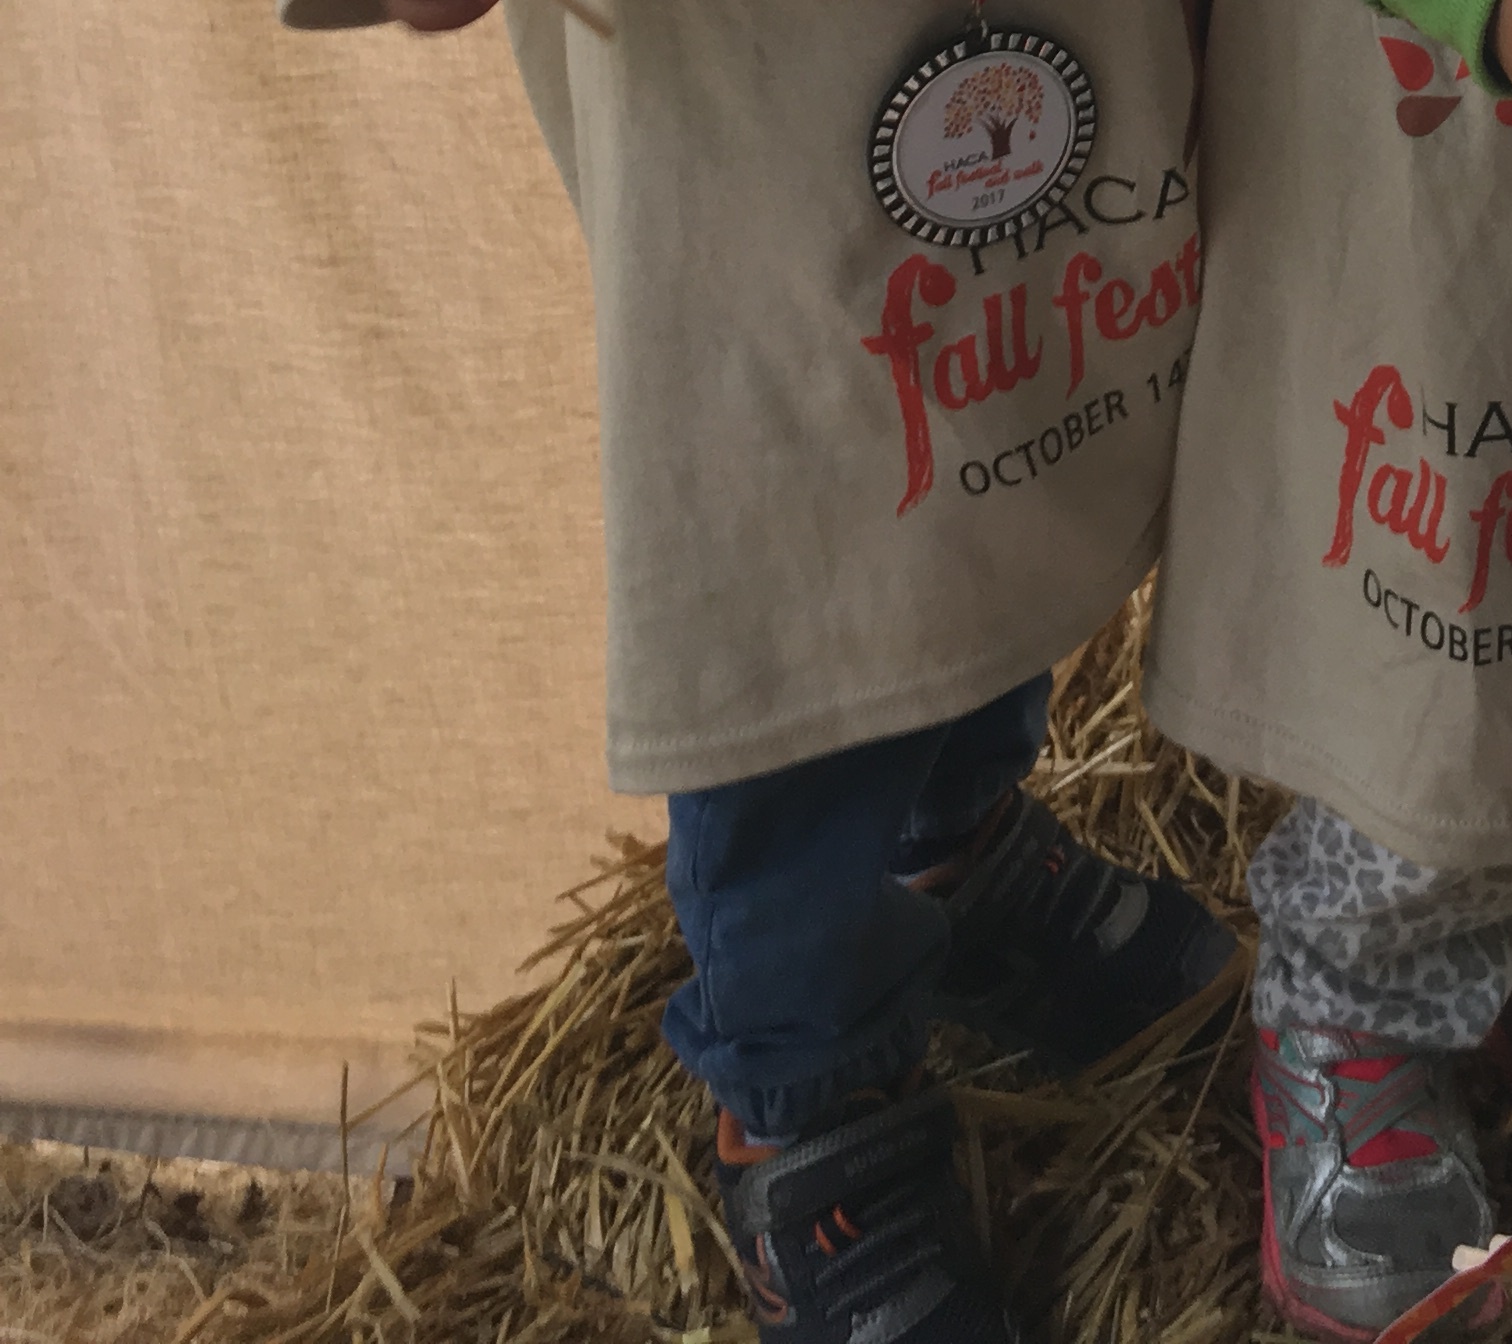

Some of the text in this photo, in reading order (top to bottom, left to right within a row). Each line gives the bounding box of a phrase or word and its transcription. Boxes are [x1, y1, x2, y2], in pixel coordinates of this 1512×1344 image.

[972, 189, 1005, 211] 2017
[860, 253, 1043, 519] fall
[959, 388, 1130, 496] OCTOBER
[1322, 364, 1450, 568] fall
